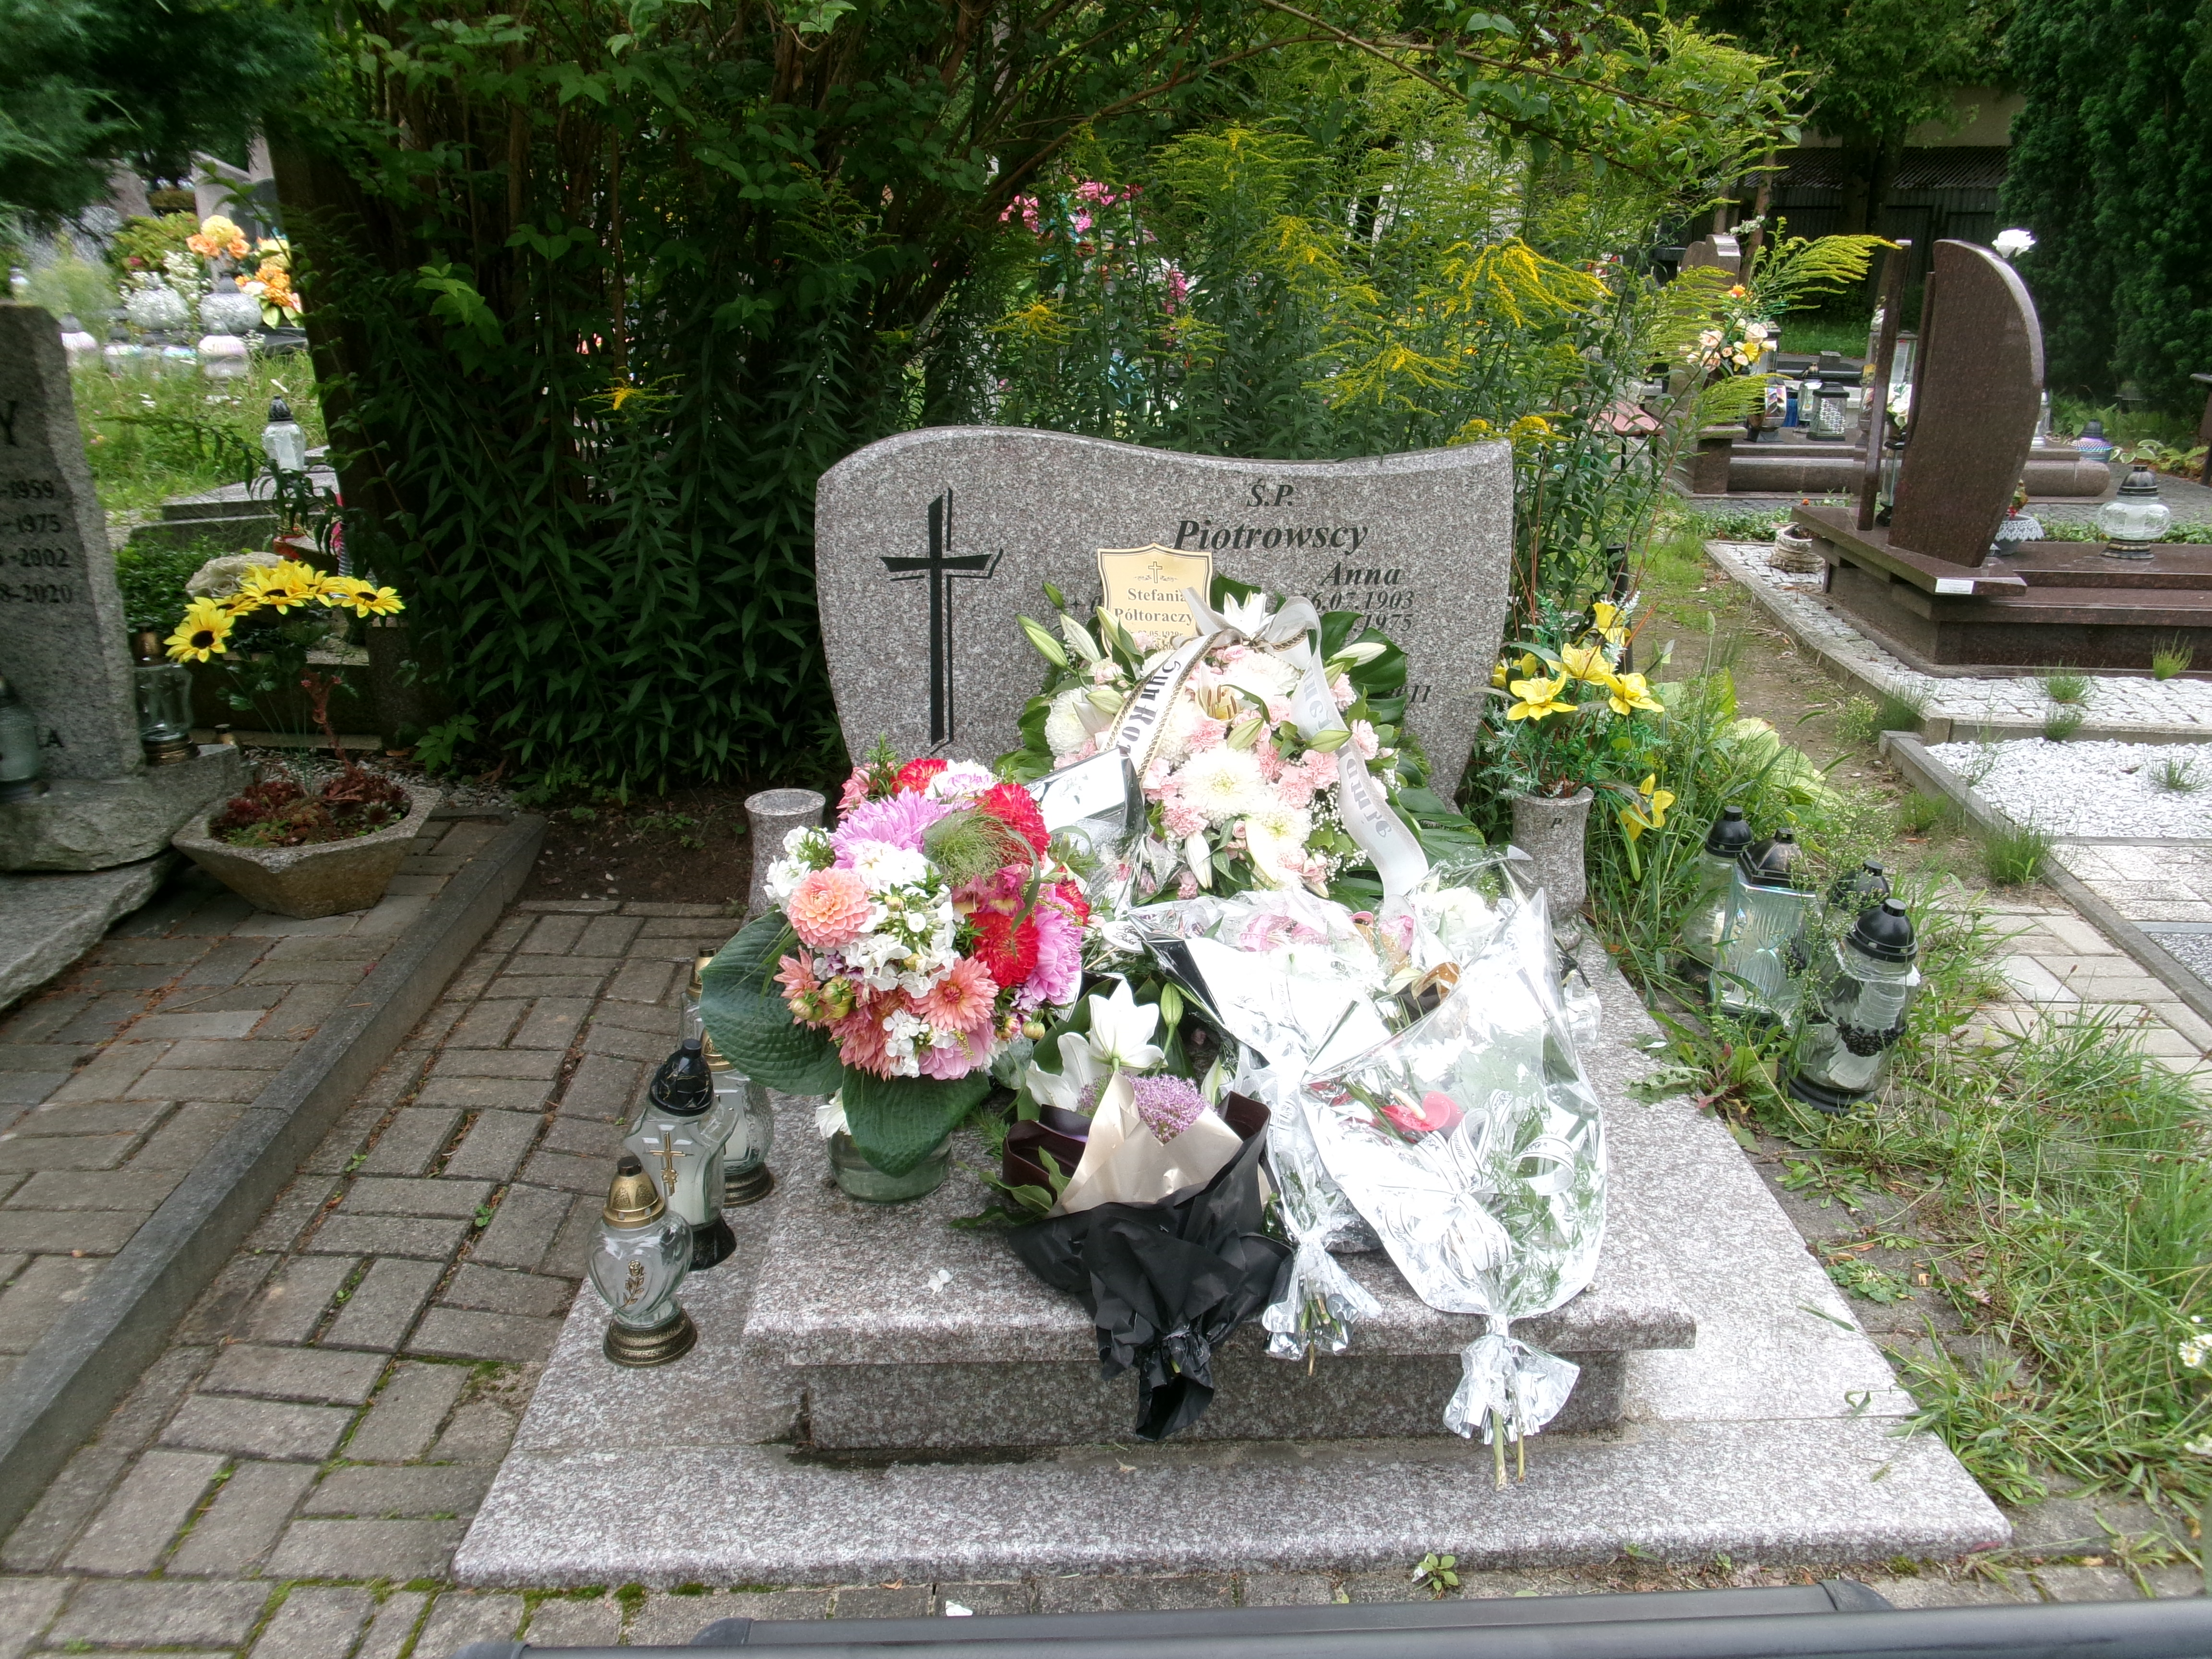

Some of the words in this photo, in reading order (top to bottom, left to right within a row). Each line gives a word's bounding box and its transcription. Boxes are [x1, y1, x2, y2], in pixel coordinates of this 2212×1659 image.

[1173, 519, 1369, 556] Piotrowscy
[1319, 562, 1401, 586] Anna
[1128, 588, 1186, 602] Stefania
[1300, 590, 1415, 611] 6.07.1903
[1114, 608, 1194, 626] Półtoraczy
